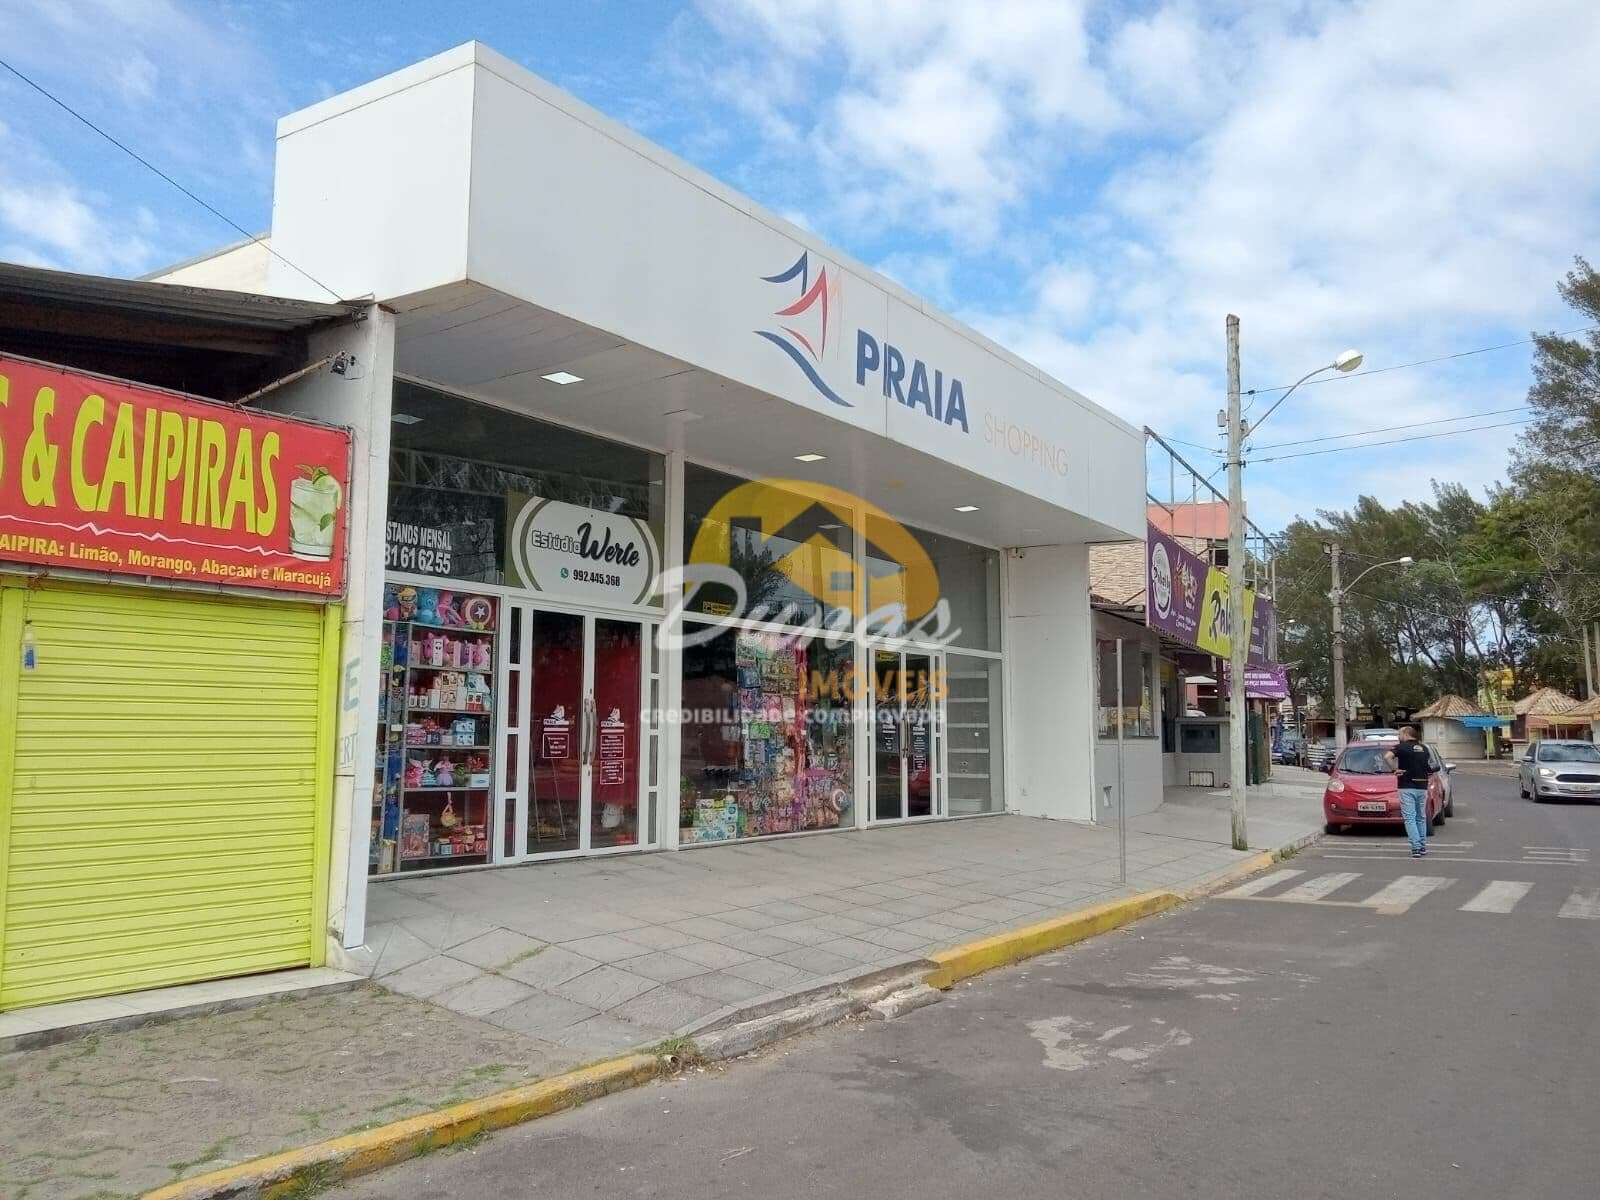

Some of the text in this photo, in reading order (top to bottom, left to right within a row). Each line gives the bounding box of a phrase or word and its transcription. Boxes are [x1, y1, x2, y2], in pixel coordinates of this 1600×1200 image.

[856, 328, 969, 434] PRAIA
[21, 386, 59, 508] &
[70, 394, 280, 538] CAIPIRAS
[983, 411, 1069, 477] SHOPPING
[386, 520, 452, 551] STANDS MENSAL
[576, 521, 640, 568] Werle
[69, 541, 123, 567] Limão,
[128, 549, 197, 576] Morango,
[201, 558, 257, 579] Abacaxi
[261, 566, 270, 580] e
[272, 566, 331, 588] Maracujá
[573, 569, 621, 587] 992.445.368
